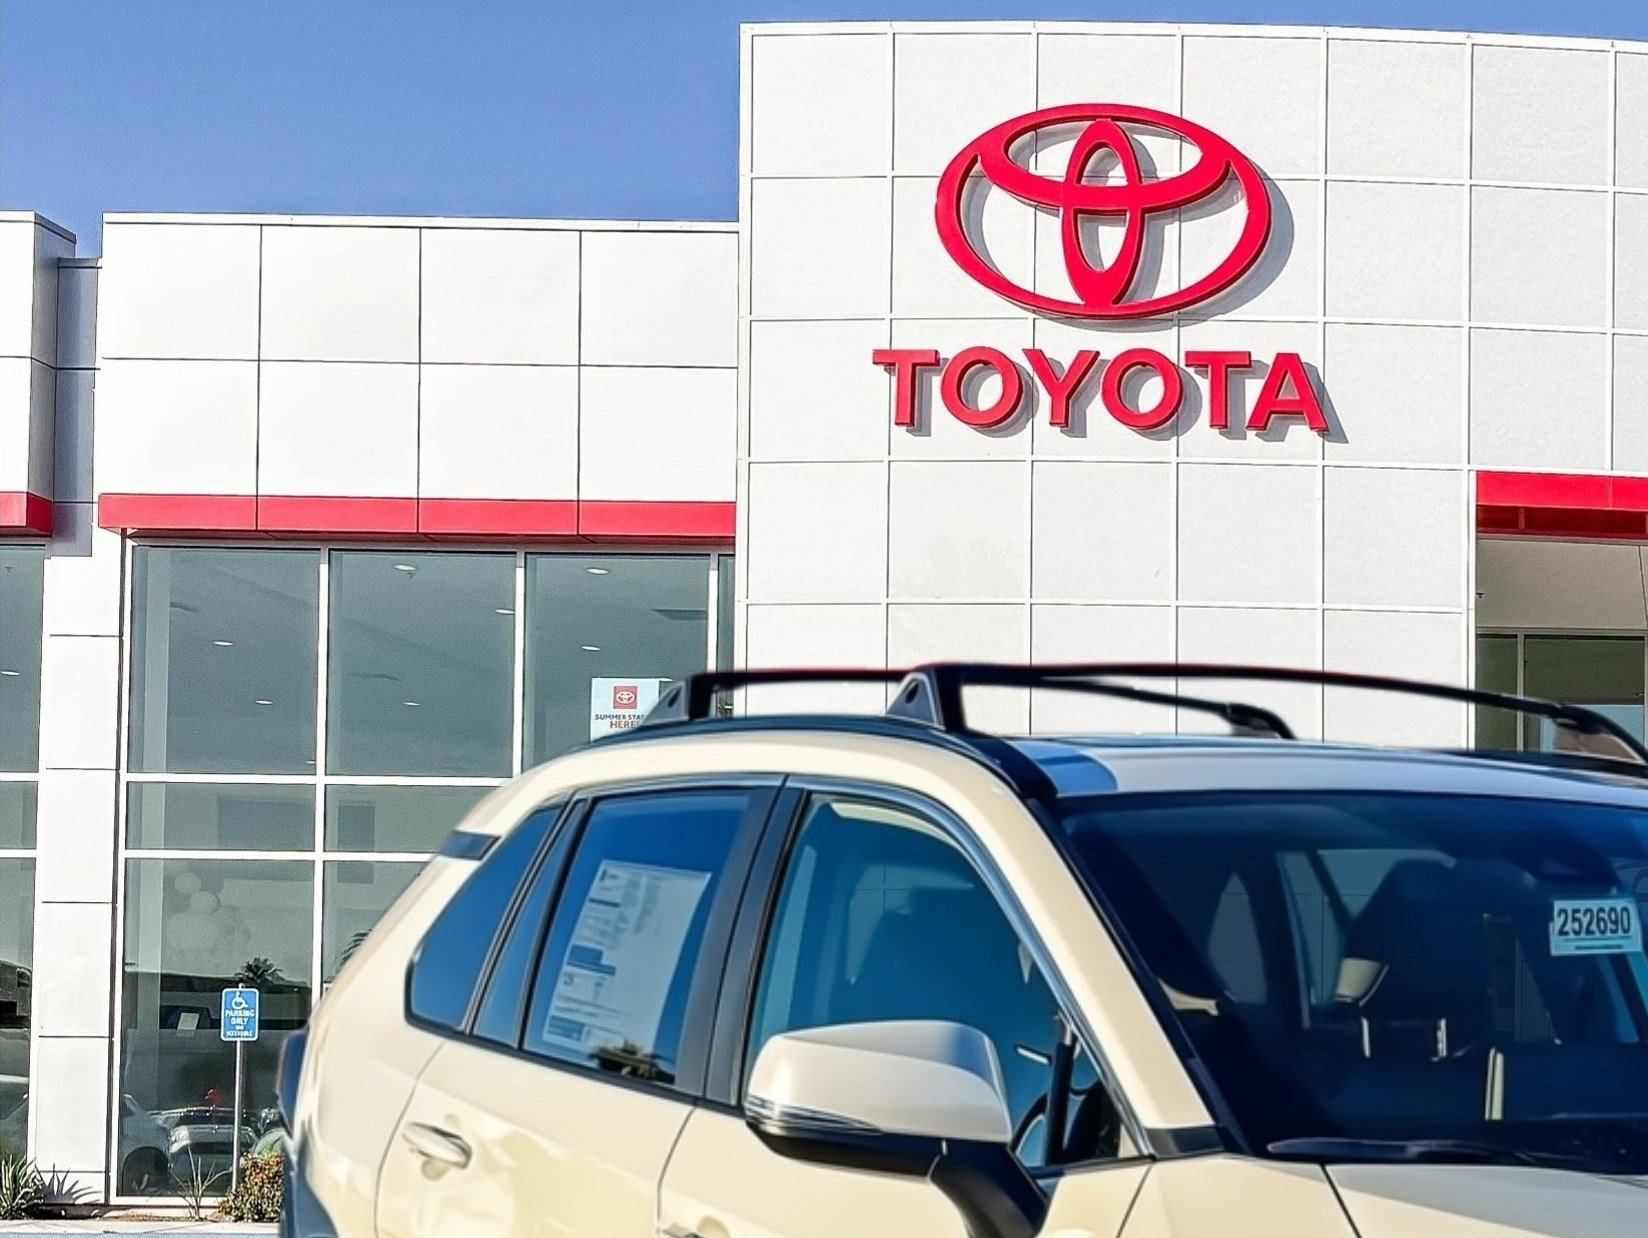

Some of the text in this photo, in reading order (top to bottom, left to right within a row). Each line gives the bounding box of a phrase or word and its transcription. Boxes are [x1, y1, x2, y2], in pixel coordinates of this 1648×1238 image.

[872, 345, 1329, 433] TOYOTA
[1557, 906, 1631, 936] 252690
[230, 1017, 249, 1025] ONLY
